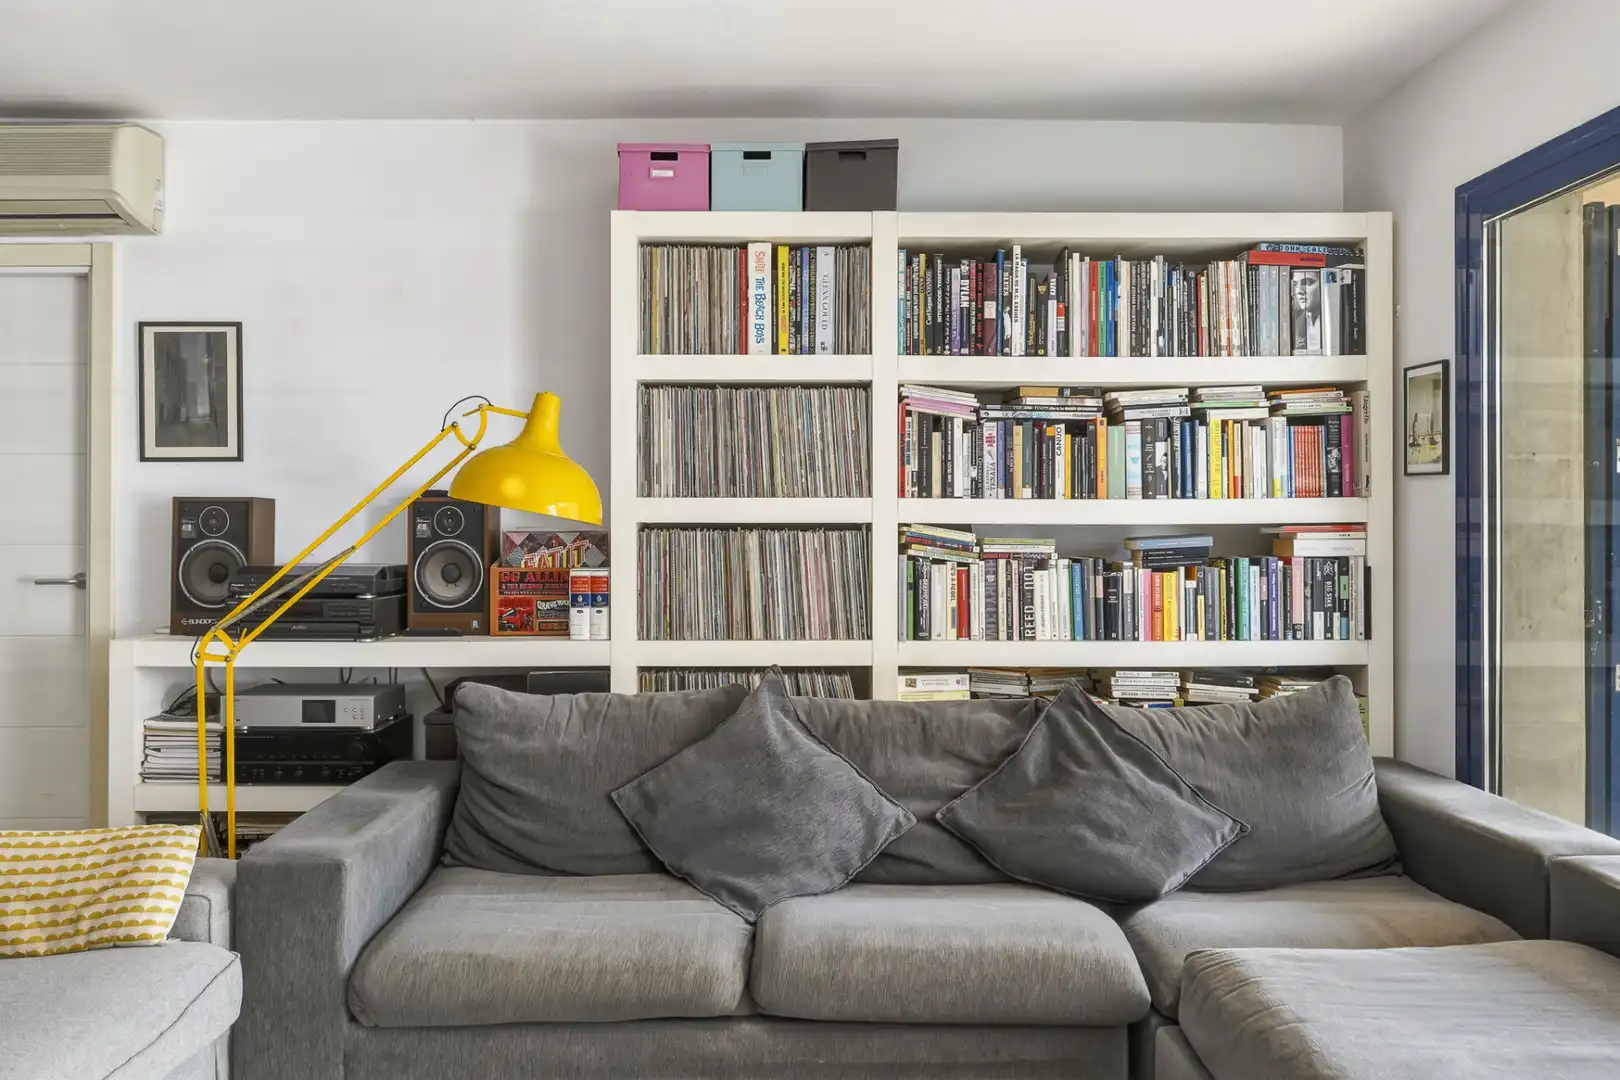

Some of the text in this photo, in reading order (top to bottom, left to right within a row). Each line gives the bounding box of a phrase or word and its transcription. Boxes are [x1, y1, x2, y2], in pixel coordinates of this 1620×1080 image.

[960, 279, 970, 308] DYLAN
[754, 277, 767, 344] THE BEACH BOYS
[1024, 605, 1036, 637] REED
